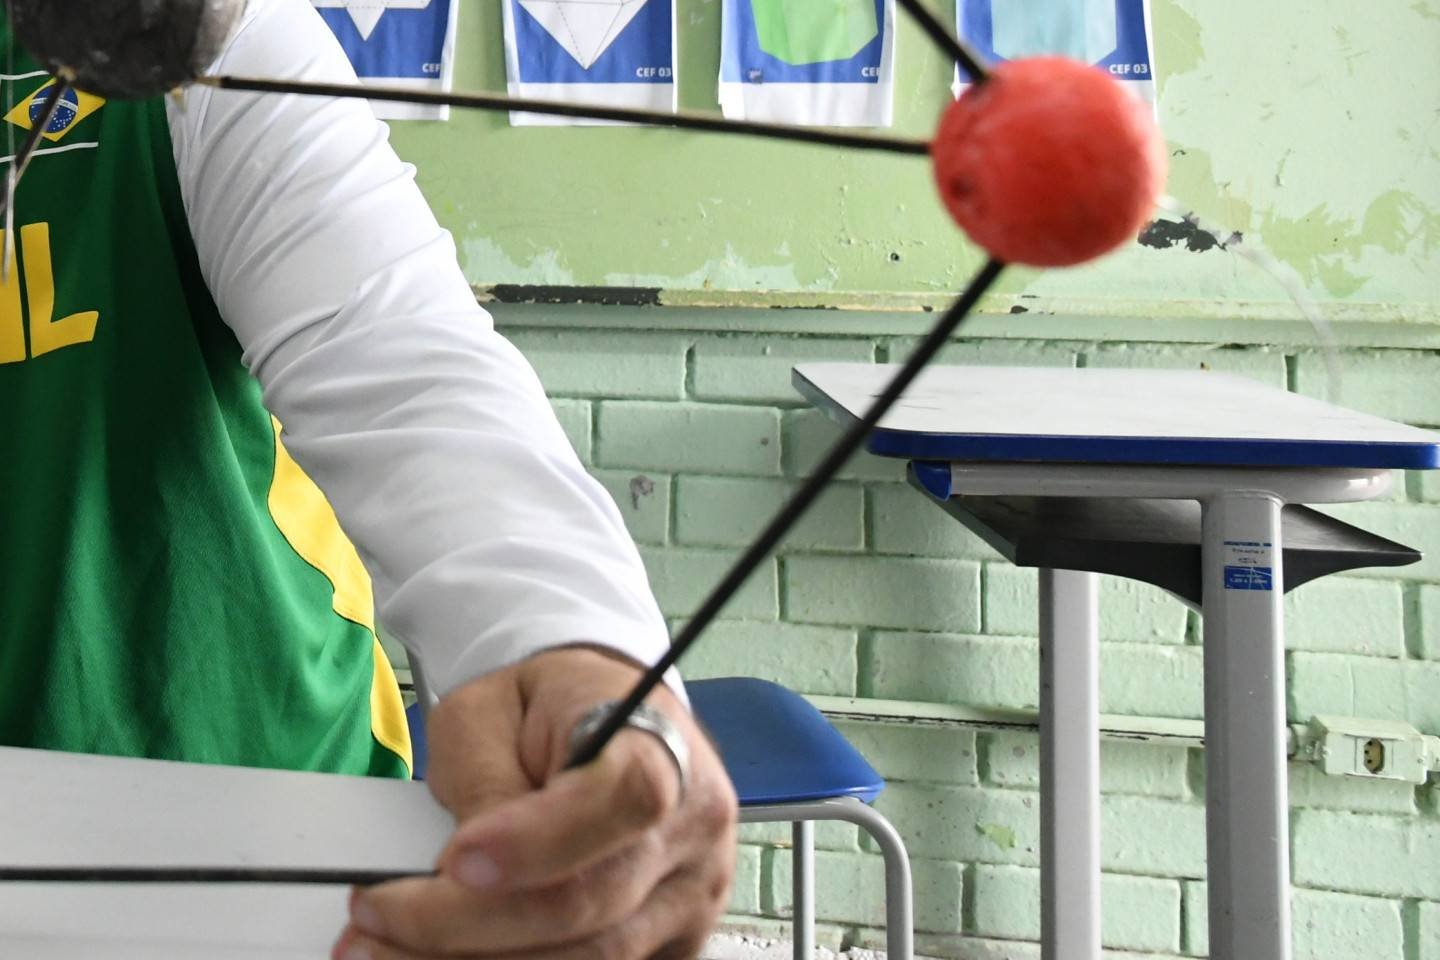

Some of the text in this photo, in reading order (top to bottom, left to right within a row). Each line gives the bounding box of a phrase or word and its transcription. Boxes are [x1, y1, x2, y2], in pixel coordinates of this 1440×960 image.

[422, 63, 441, 73] CEF
[636, 67, 672, 77] CEF 03
[1109, 64, 1148, 74] CEF 03
